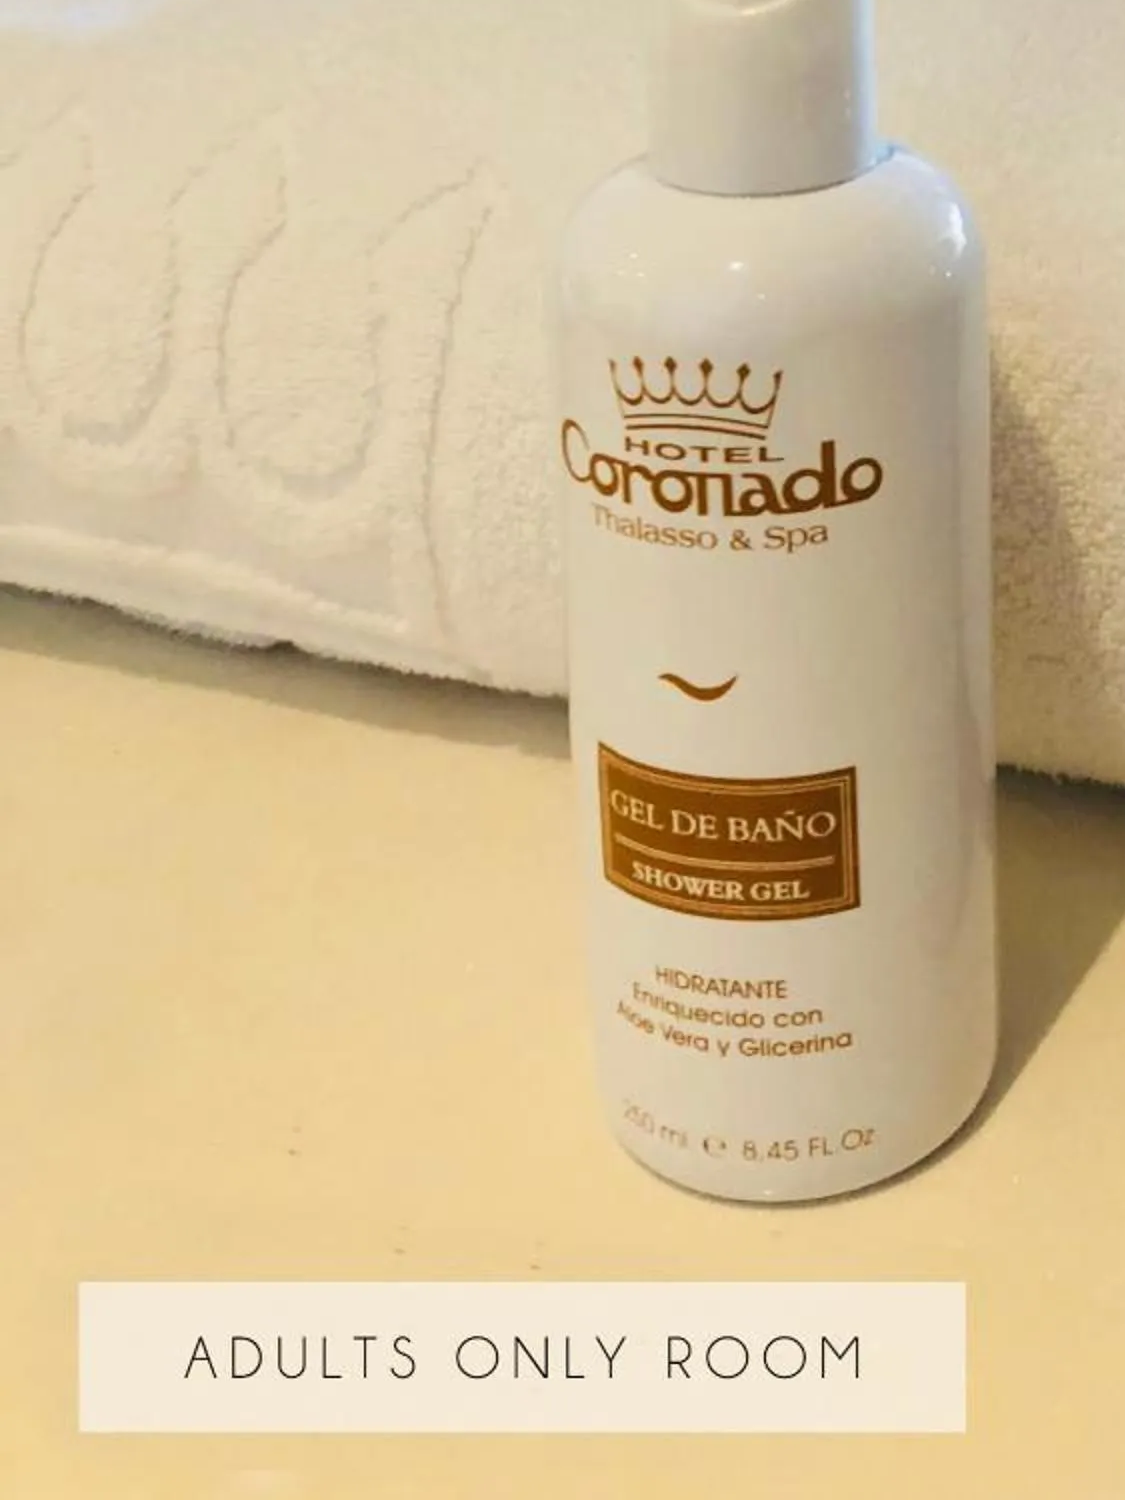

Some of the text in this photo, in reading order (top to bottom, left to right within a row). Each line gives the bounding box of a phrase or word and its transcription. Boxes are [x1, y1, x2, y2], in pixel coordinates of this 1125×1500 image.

[561, 419, 882, 517] Coronado
[625, 436, 784, 463] HOTEL
[591, 502, 829, 553] Thalasso & Spa
[609, 788, 837, 842] GEL DE BAÑO
[632, 861, 810, 901] SHOWER GEL
[655, 965, 788, 999] HIDRATANTE
[632, 982, 823, 1028] Enriquecido con
[661, 1022, 709, 1051] Vera
[738, 1032, 853, 1057] Glicerina
